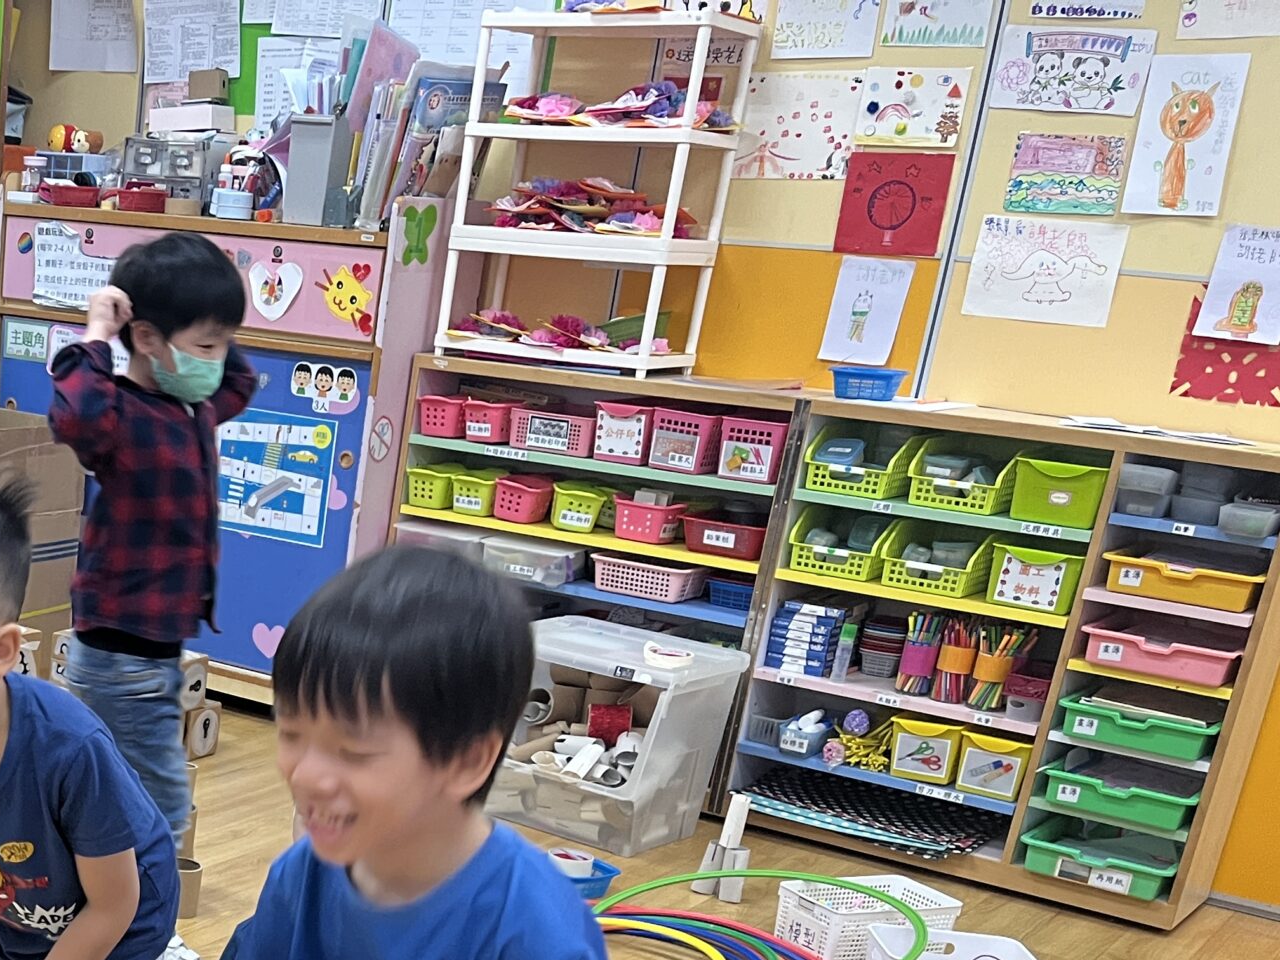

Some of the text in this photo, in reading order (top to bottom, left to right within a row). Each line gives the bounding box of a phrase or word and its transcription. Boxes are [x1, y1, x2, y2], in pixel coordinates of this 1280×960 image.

[1180, 70, 1212, 86] cat
[54, 244, 65, 253] 2-4
[10, 329, 45, 349] 主題角
[314, 400, 328, 411] 3人
[604, 428, 635, 440] 公仔印
[455, 497, 481, 507] 圖工物料
[560, 512, 590, 524] 圖工物料
[1022, 523, 1061, 536] 泥膠用具
[1019, 564, 1045, 577] 圖工
[1013, 582, 1040, 598] 物料
[1095, 873, 1124, 887] 再用紙
